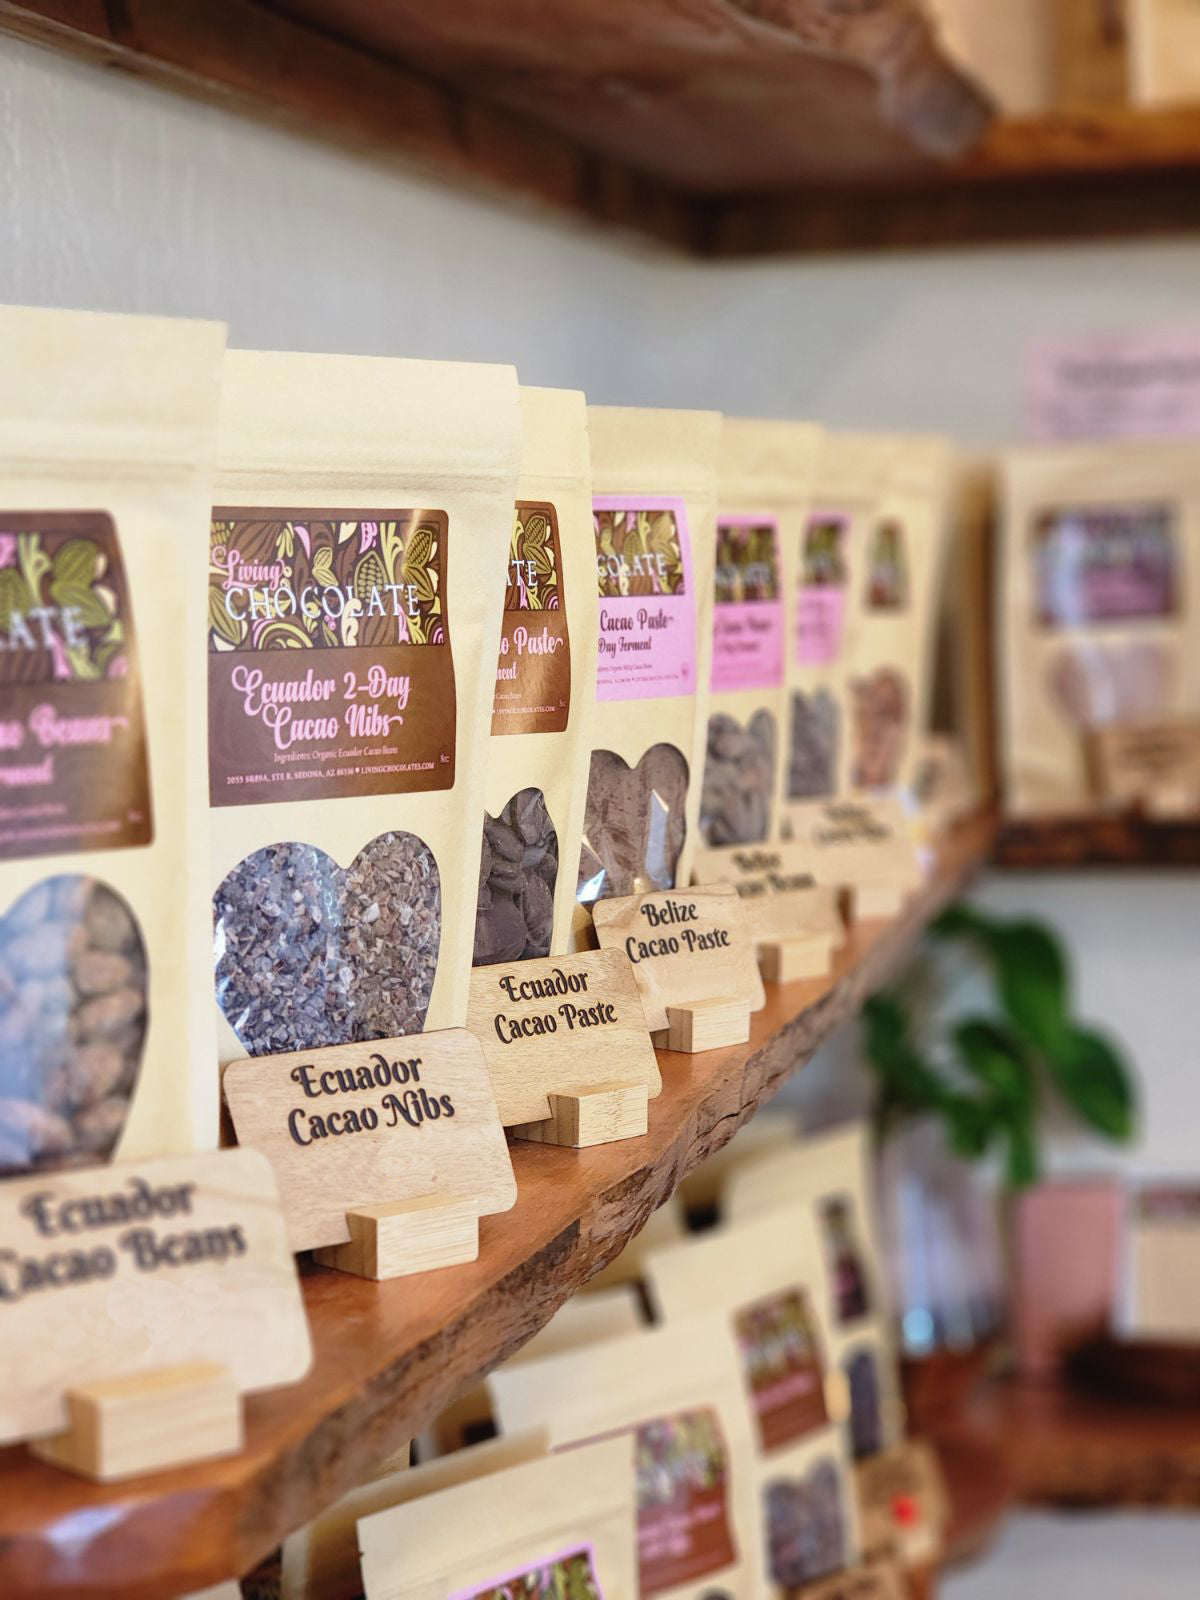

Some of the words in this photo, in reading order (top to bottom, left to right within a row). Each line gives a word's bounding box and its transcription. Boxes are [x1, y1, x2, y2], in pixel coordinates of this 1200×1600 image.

[211, 545, 287, 591] Living
[225, 582, 421, 621] CHOCOLATE
[600, 609, 634, 632] Cacao
[636, 608, 674, 631] Paste
[514, 626, 564, 656] Paste
[597, 637, 617, 659] Day
[231, 665, 336, 716] Ecuador
[343, 664, 413, 710] 2-Day
[262, 703, 340, 750] Cacao
[344, 703, 404, 738] Nibs
[640, 899, 699, 928] Belize
[625, 936, 680, 964] Cacao
[681, 927, 731, 953] Paste
[499, 968, 589, 1003] Ecuador
[494, 1013, 558, 1045] Cacao
[558, 1001, 618, 1031] Paste
[290, 1053, 423, 1098] Ecuador
[287, 1107, 379, 1146] Cacao
[381, 1087, 456, 1127] Nibs
[19, 1176, 197, 1239] Ecuador
[118, 1223, 248, 1273] Beans
